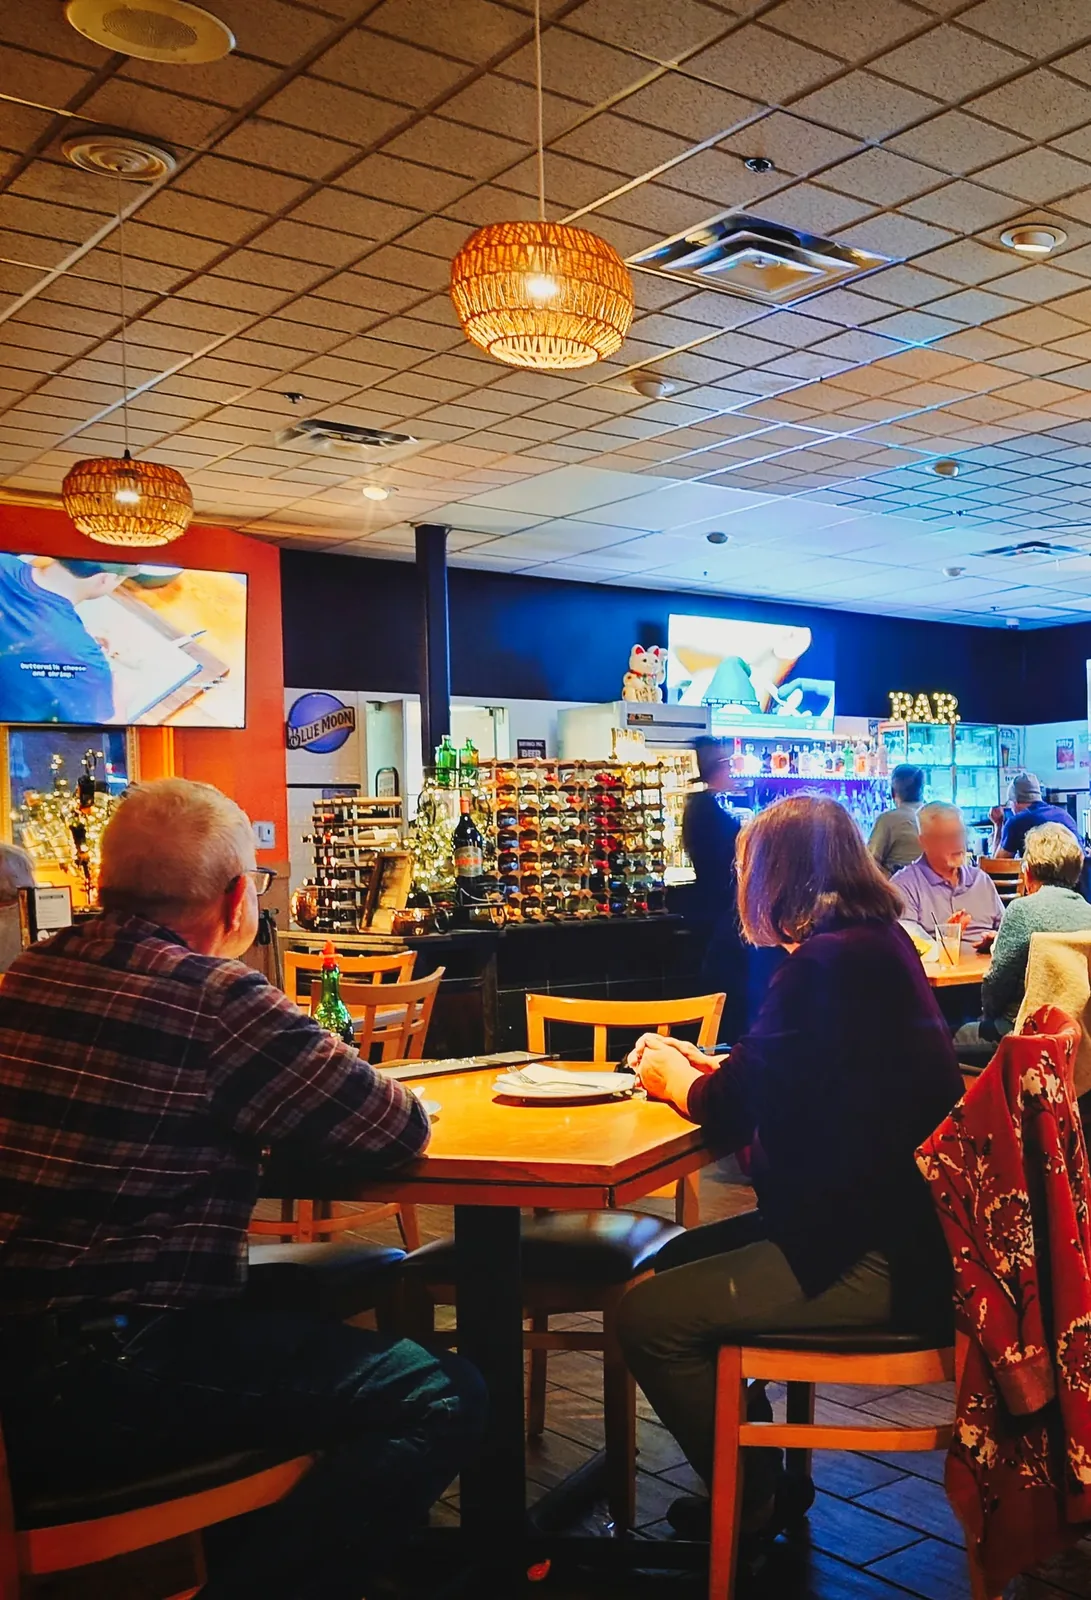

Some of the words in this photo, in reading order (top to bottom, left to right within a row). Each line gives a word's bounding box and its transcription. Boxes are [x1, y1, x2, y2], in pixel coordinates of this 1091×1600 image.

[888, 691, 961, 724] BAR
[288, 723, 320, 748] BLUE
[321, 710, 352, 733] MOON
[521, 749, 542, 758] BEER
